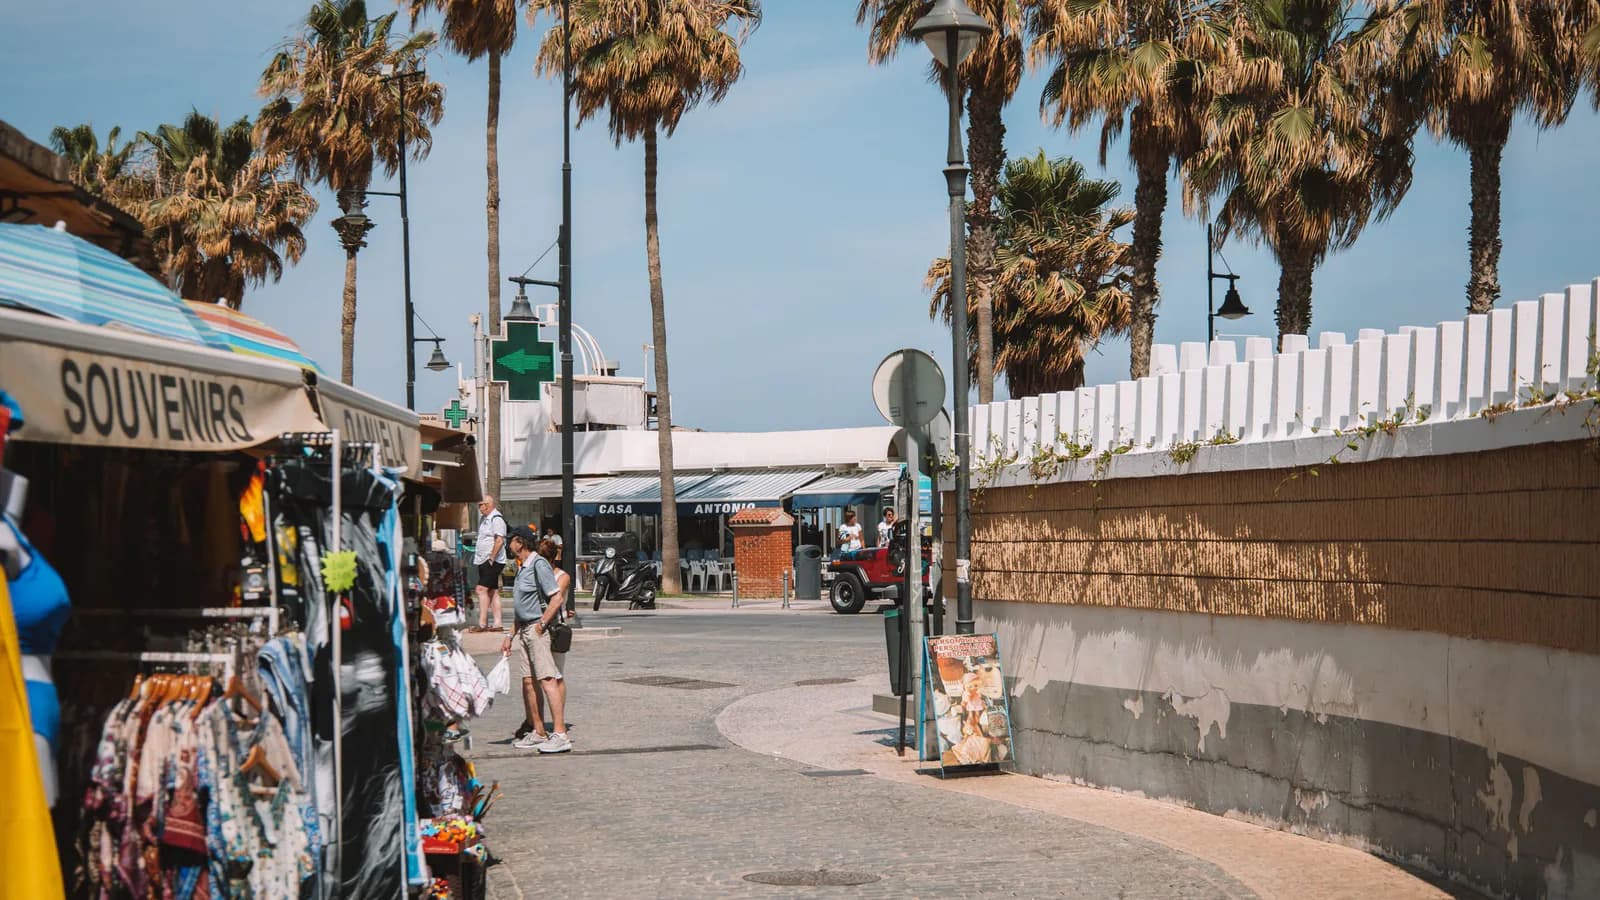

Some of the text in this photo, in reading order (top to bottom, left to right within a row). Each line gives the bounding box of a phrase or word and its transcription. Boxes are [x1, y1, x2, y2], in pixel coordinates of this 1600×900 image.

[61, 358, 254, 443] SOUVENIRS
[599, 502, 756, 514] CASA ANTONIO
